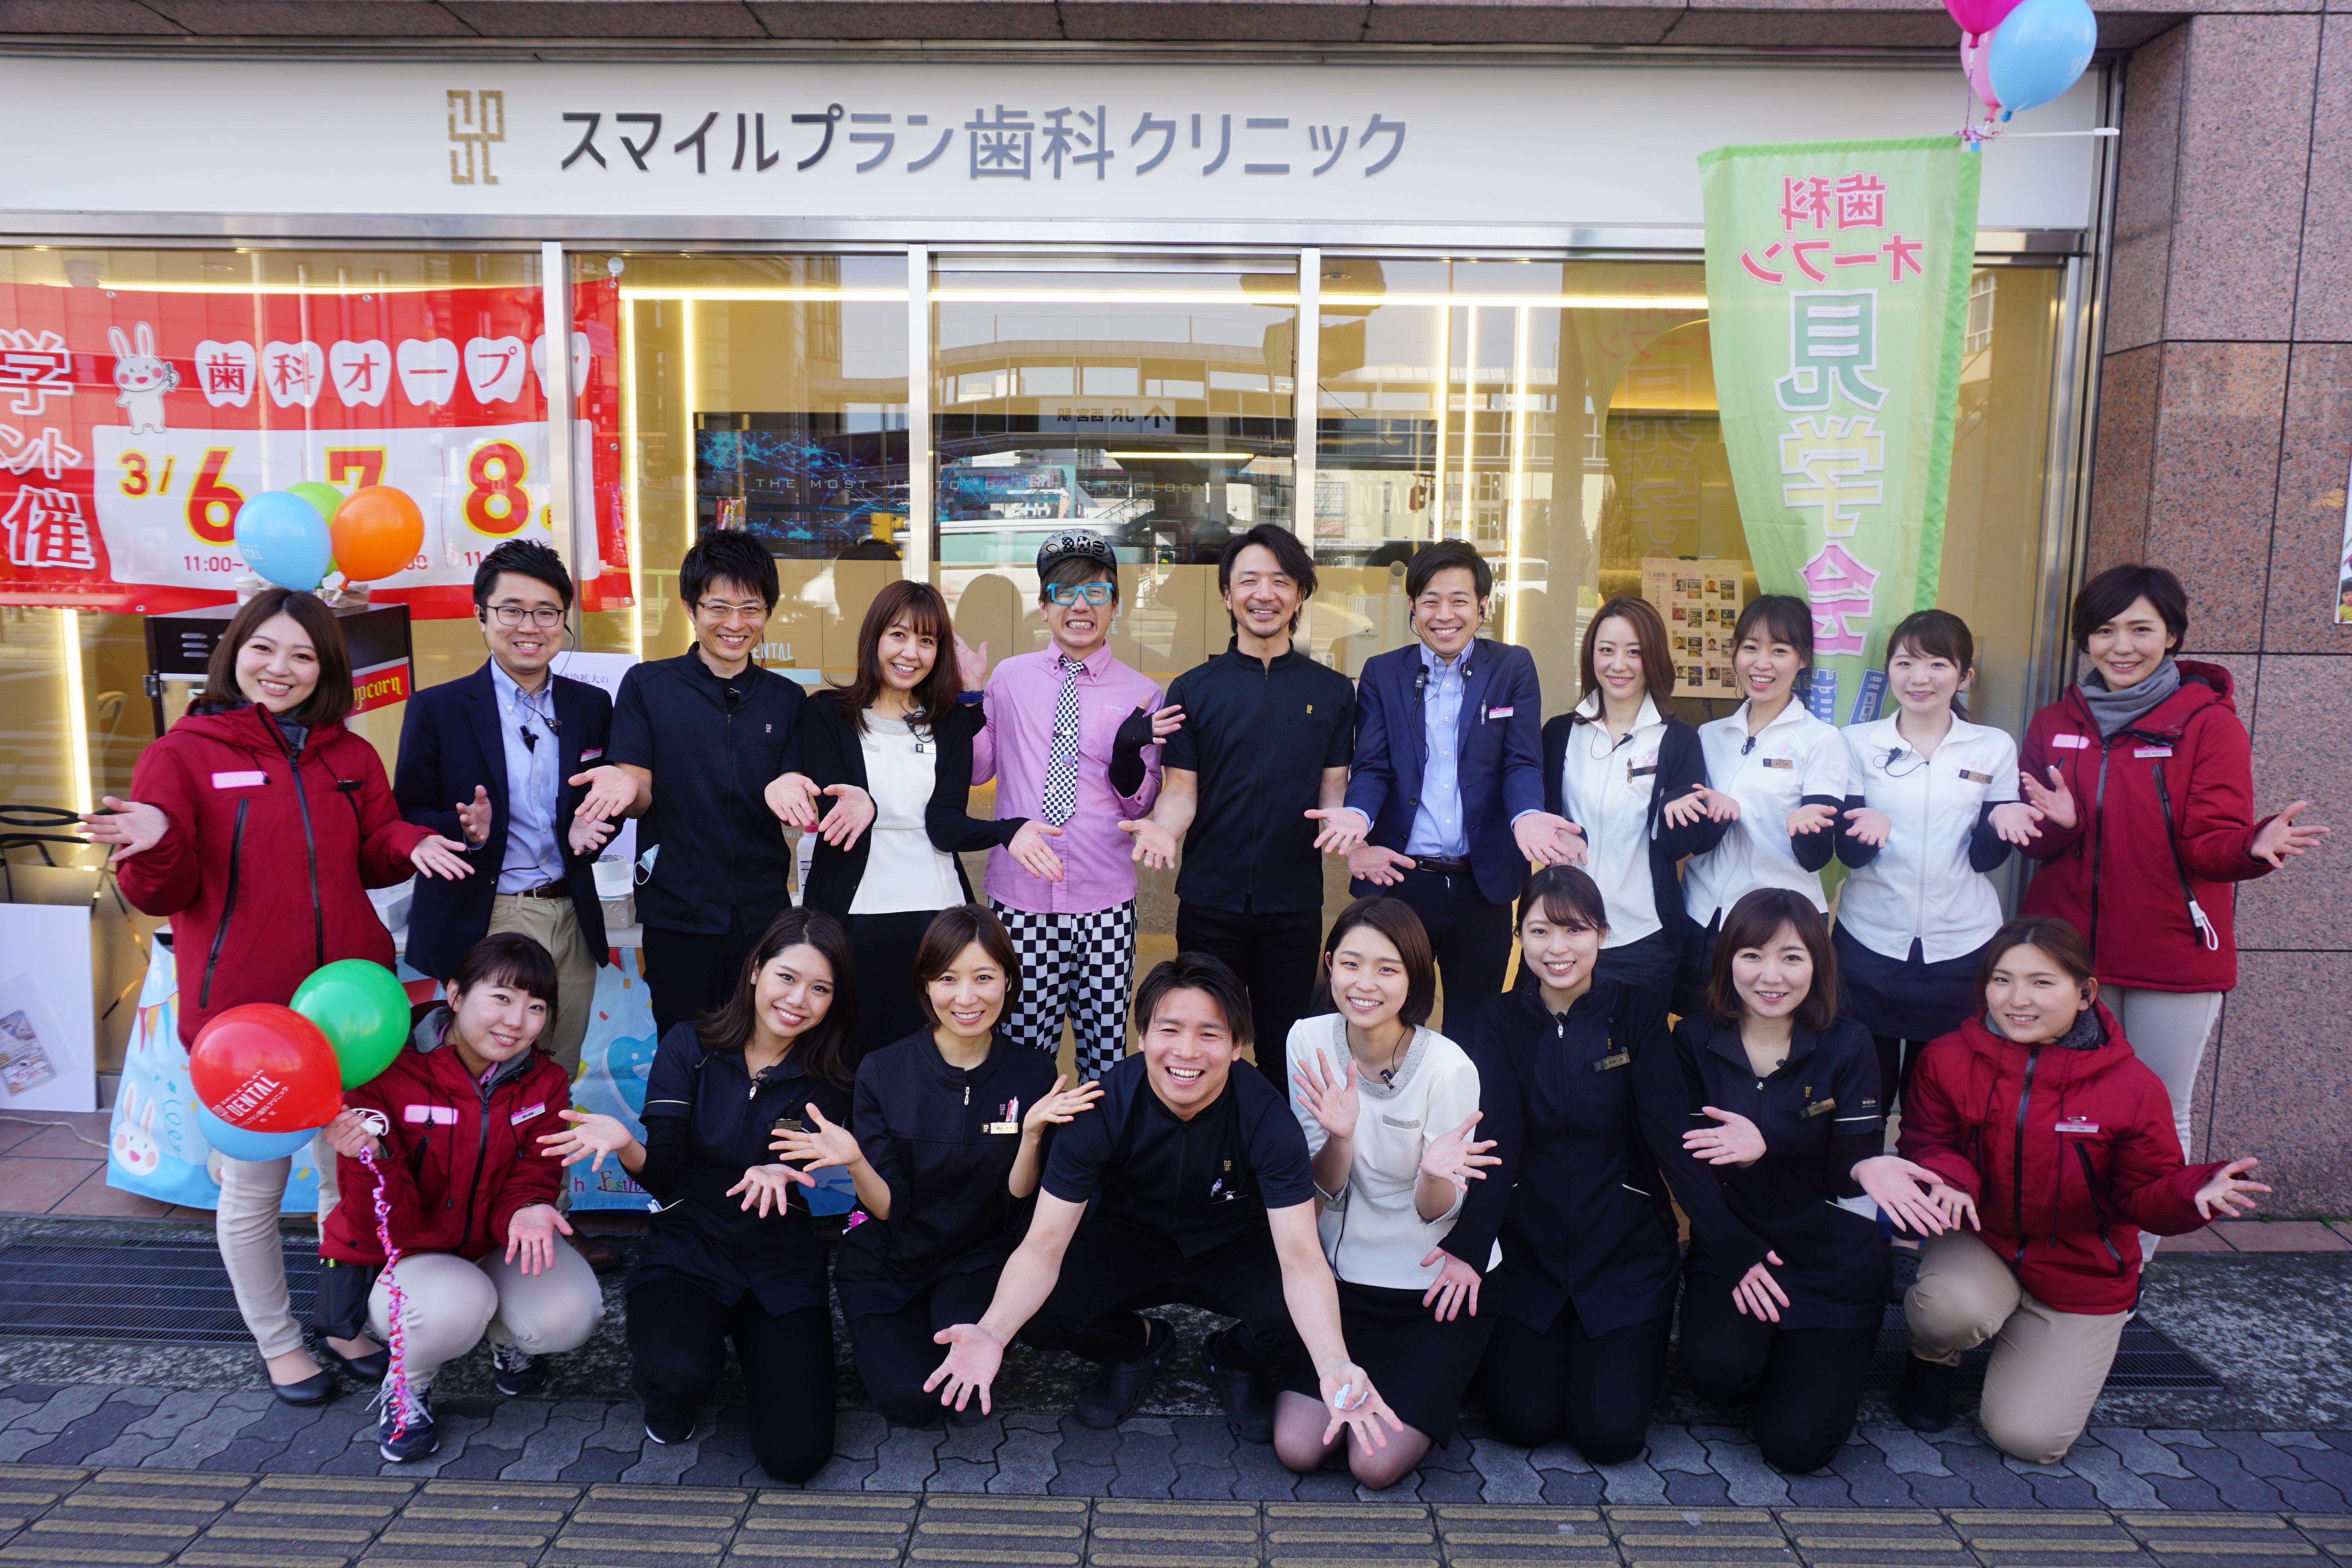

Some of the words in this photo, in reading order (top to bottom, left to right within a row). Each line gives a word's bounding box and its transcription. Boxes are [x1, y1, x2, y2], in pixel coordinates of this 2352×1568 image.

[560, 102, 1406, 180] スマイルプラン歯科クリニック
[207, 344, 579, 397] 歯科オープ
[461, 438, 533, 539] 8
[756, 478, 795, 489] THE
[811, 479, 867, 489] MOST
[935, 481, 959, 490] TO
[1, 483, 97, 570] 催
[752, 642, 794, 659] ENTAL
[220, 1087, 242, 1105] SMILE
[242, 1069, 265, 1088] PLAN
[225, 1075, 281, 1118] DENTAL
[597, 1170, 648, 1192] Festiv
